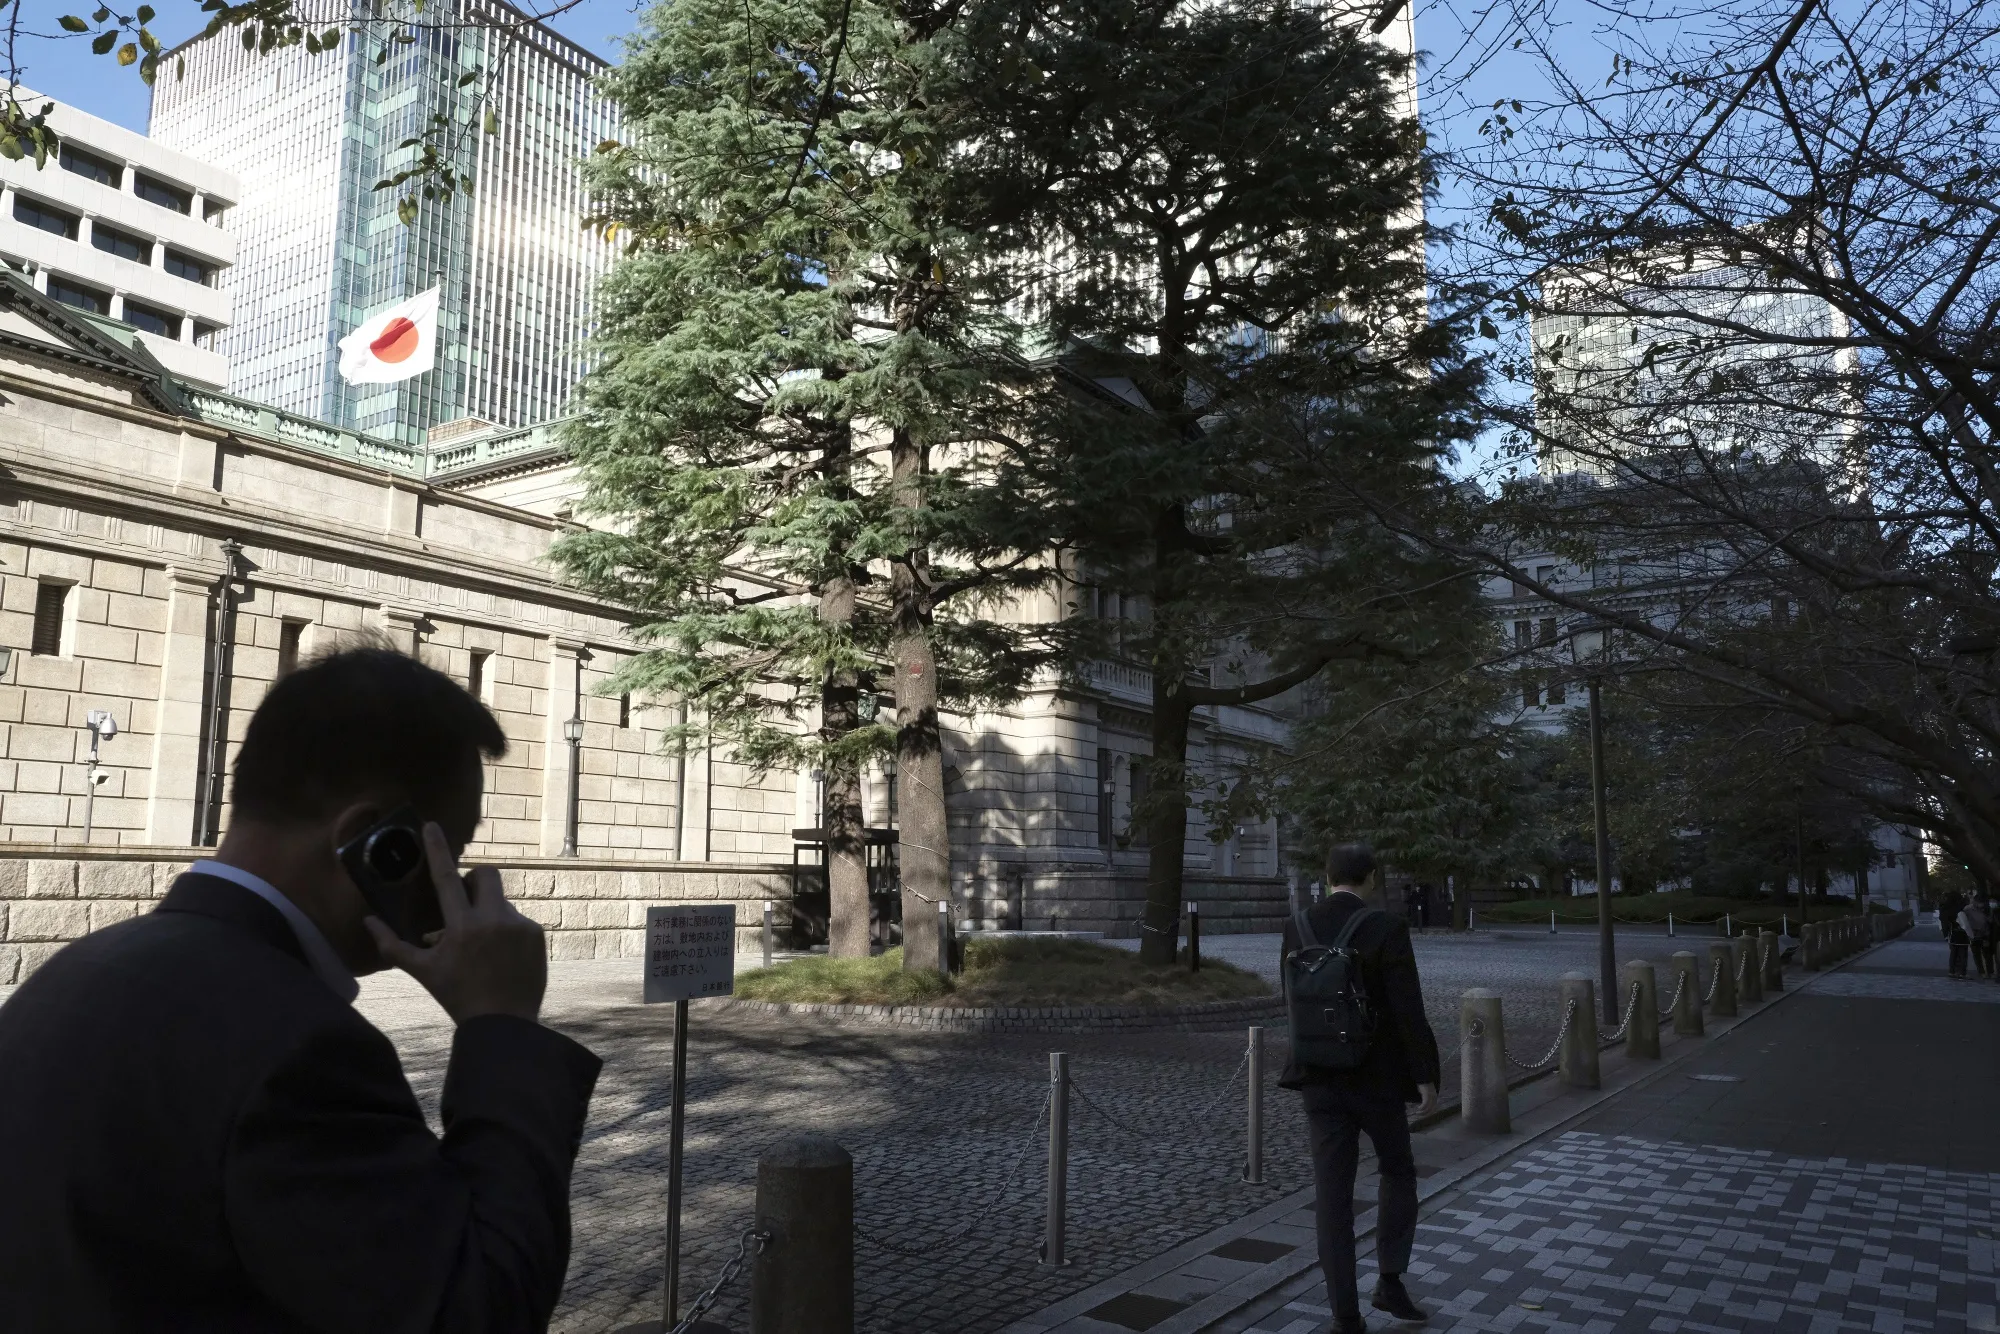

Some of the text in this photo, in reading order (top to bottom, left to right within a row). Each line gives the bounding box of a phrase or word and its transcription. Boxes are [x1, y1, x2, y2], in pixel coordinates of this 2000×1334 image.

[654, 915, 732, 929] 本行業務に関係のない
[653, 930, 729, 945] 方は、敷地内および
[652, 946, 729, 962] 建物内への立入りは
[652, 964, 708, 977] ご遠慮下さい。
[702, 981, 730, 992] 日本銀行
